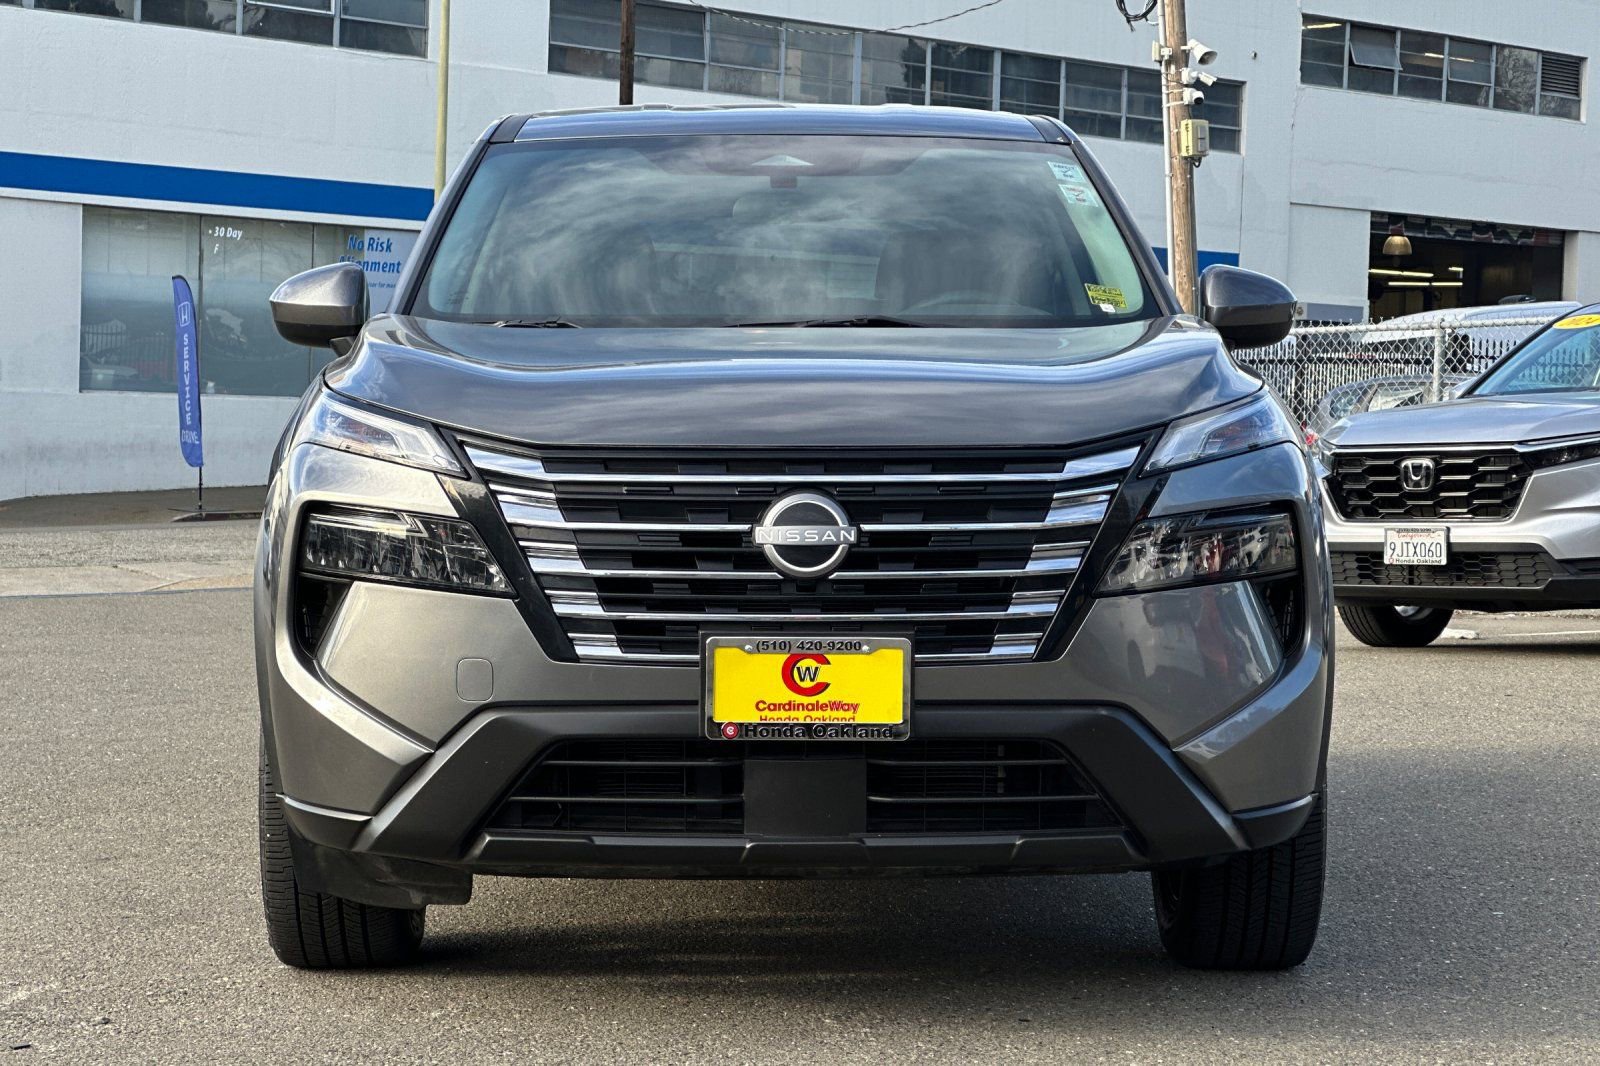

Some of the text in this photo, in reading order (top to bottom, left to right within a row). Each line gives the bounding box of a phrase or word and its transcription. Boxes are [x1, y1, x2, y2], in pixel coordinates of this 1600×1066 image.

[214, 226, 243, 241] 30 Day
[348, 235, 393, 253] No Risk
[182, 333, 192, 425] SERVICE
[759, 530, 855, 542] NISSAN
[756, 640, 862, 653] (510) 420-9200
[755, 700, 860, 714] CardinaleWay
[744, 723, 893, 738] Honda Oakland
